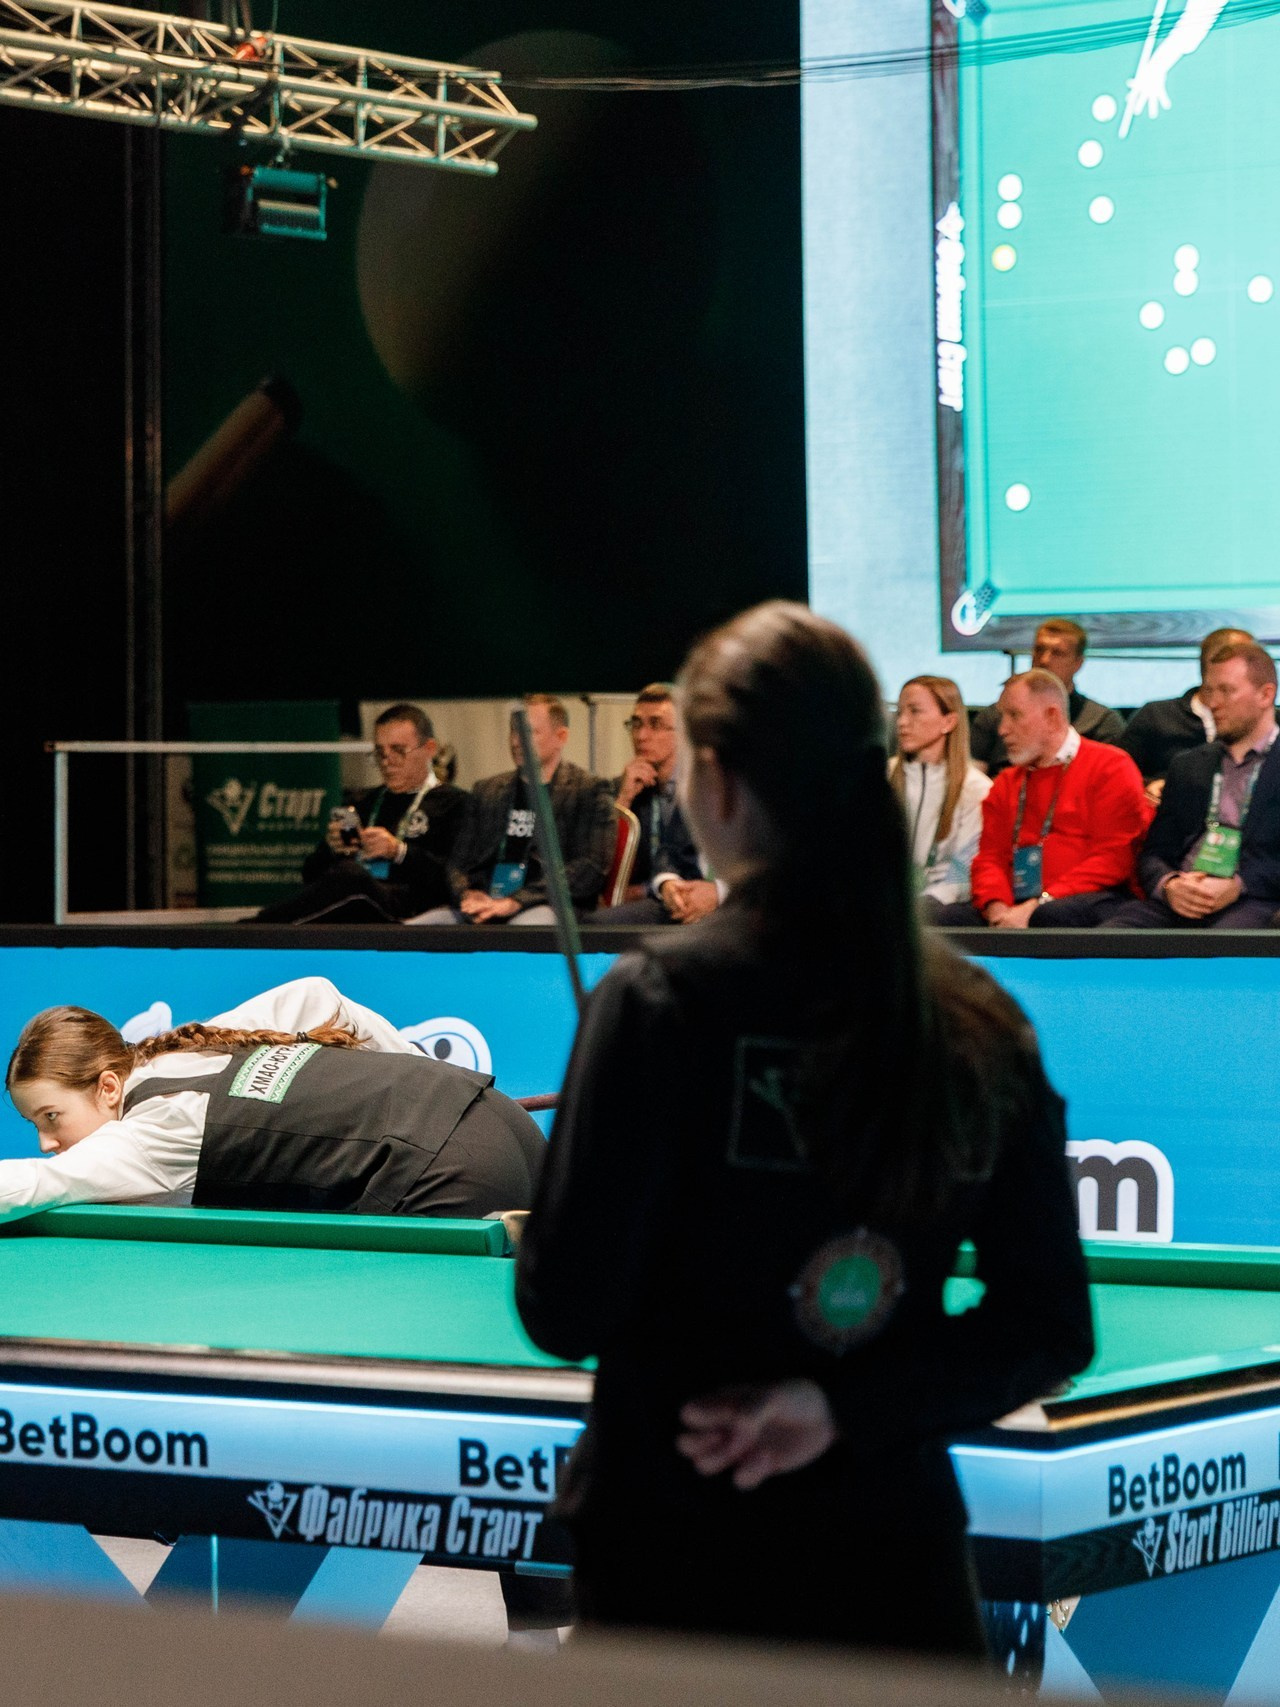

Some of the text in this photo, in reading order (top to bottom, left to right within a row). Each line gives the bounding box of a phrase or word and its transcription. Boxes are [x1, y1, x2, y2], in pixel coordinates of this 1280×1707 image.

[259, 782, 325, 823] Старт
[1108, 1452, 1246, 1517] BetBoom
[298, 1485, 544, 1559] Фабрика Старт
[1164, 1496, 1280, 1574] Start Billiar
